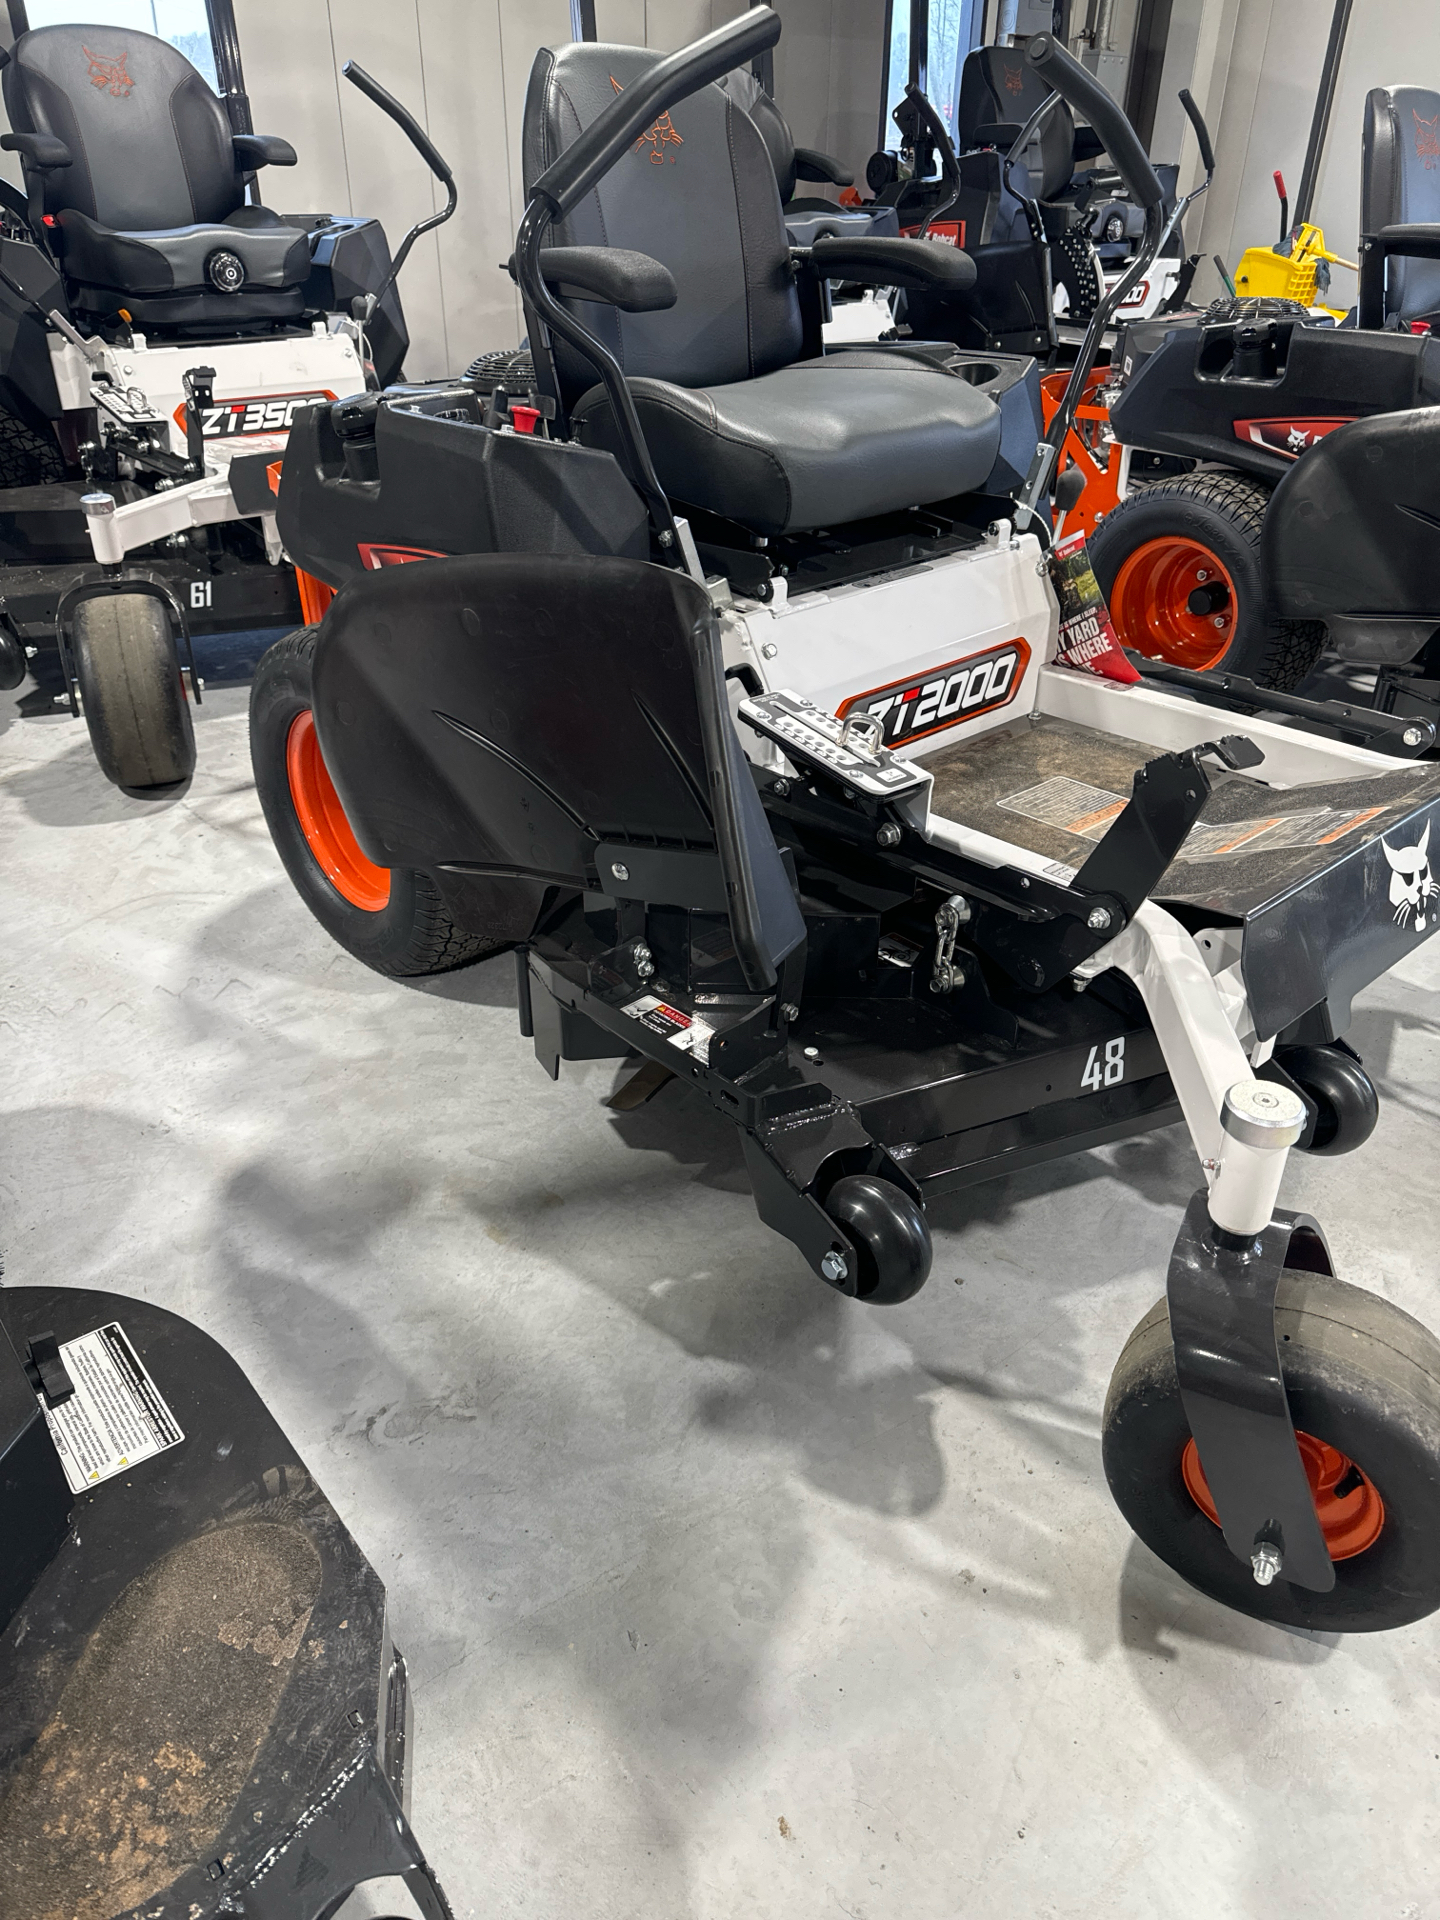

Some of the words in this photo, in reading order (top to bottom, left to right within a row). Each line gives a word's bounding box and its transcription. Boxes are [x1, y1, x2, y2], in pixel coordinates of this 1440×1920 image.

[202, 397, 329, 435] ZT350
[190, 580, 212, 609] 61
[1066, 616, 1100, 647] YARD
[1066, 632, 1113, 665] WHERE
[864, 652, 1018, 737] ZT2000
[1080, 1036, 1126, 1091] 48
